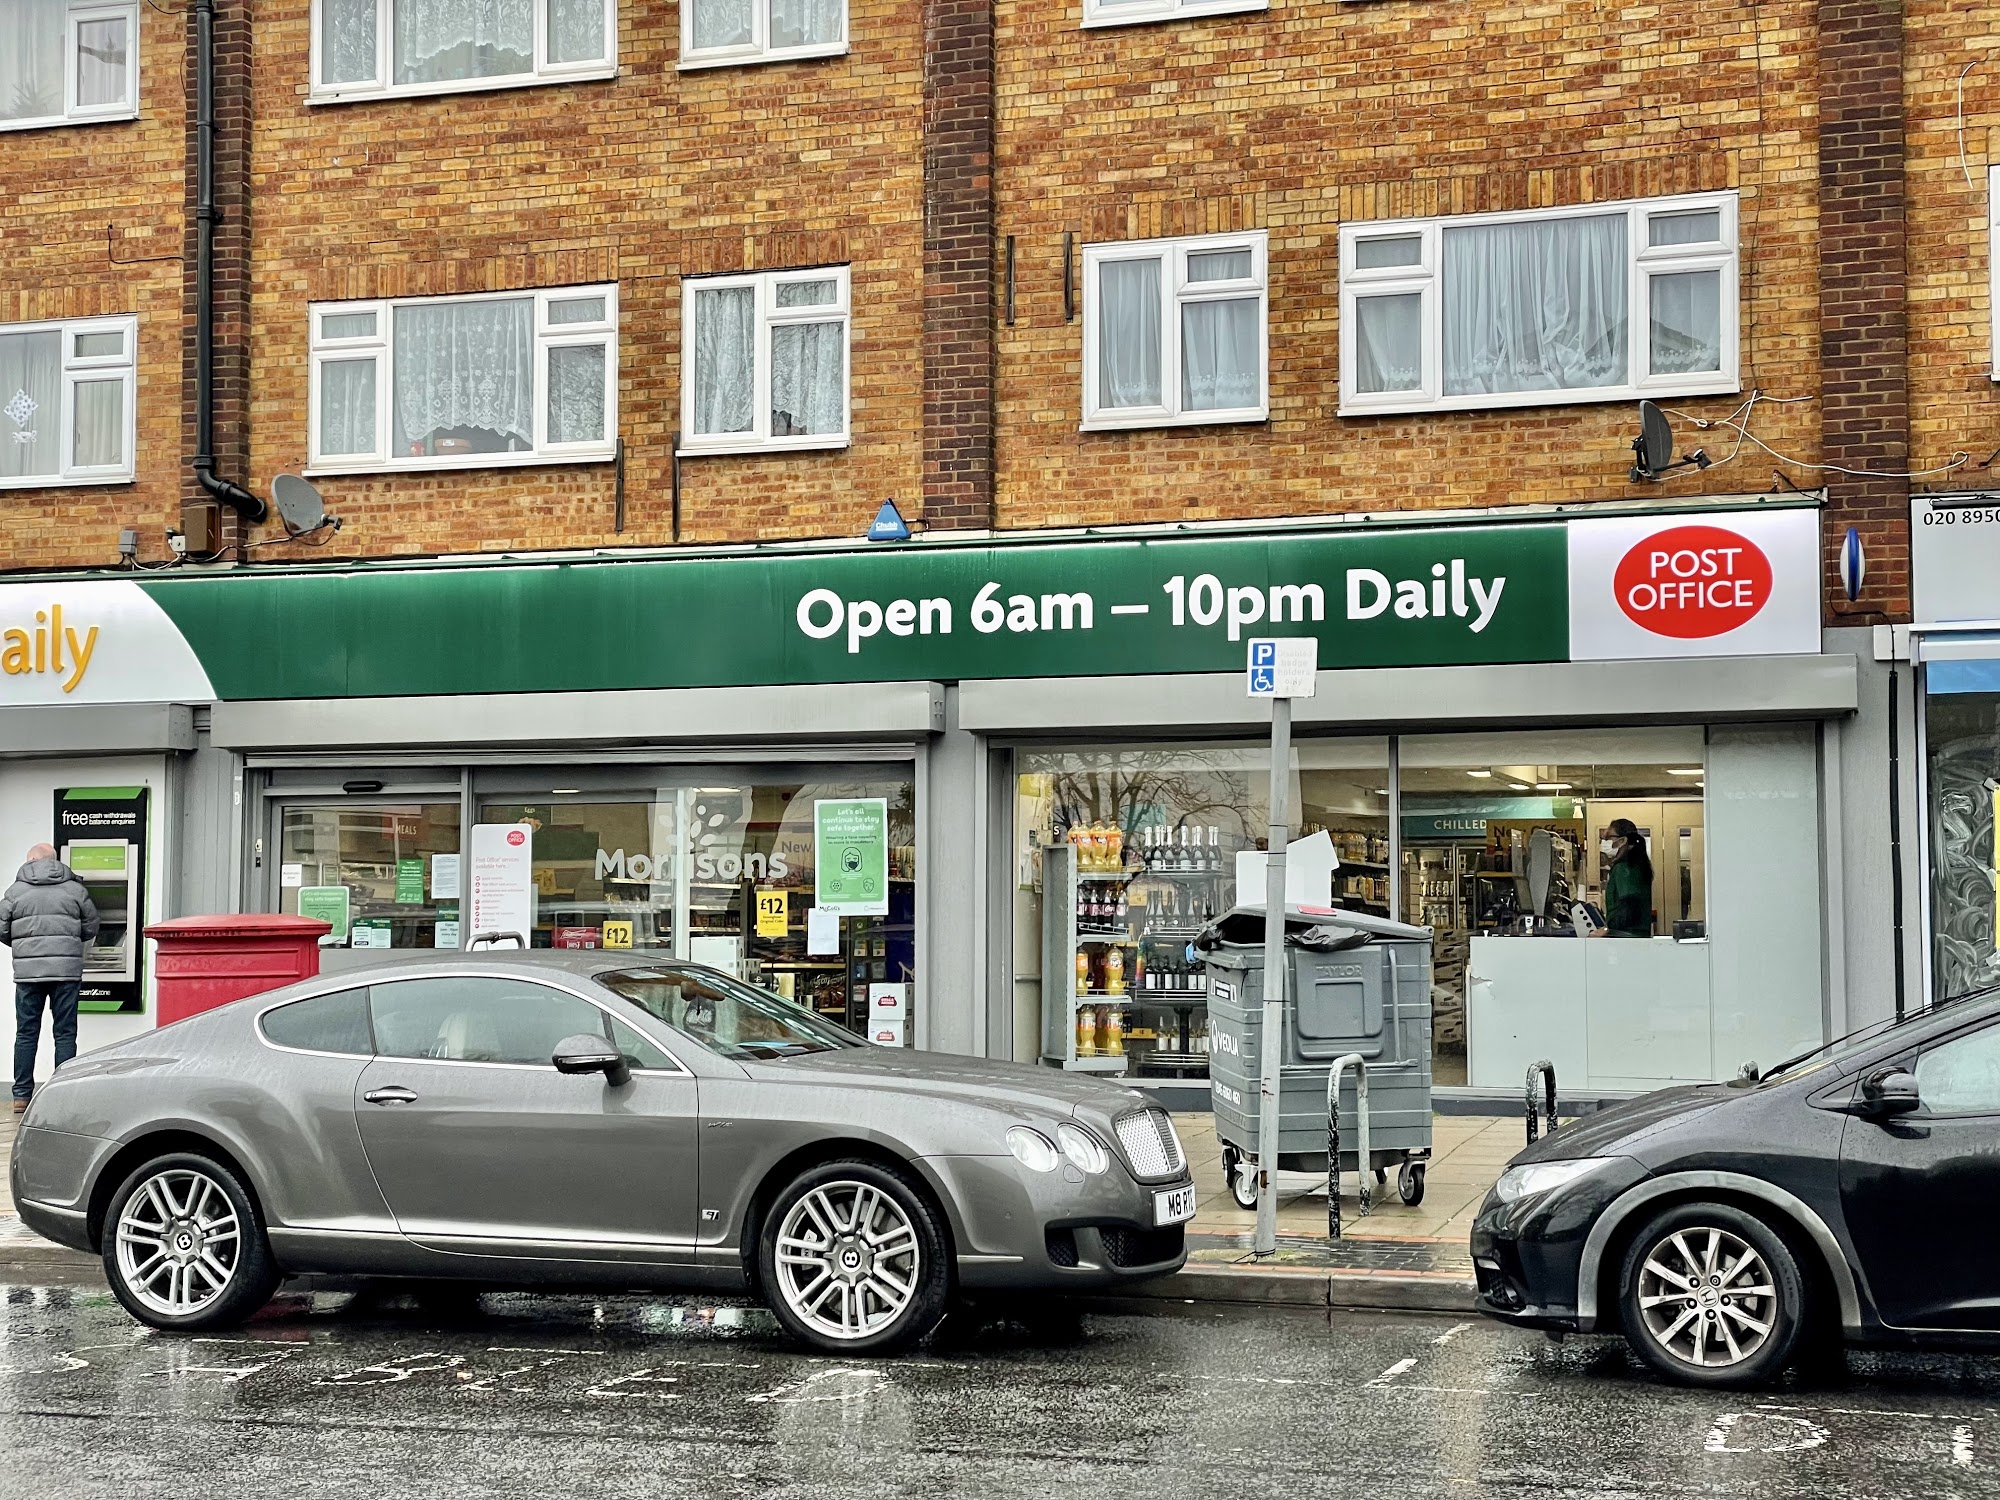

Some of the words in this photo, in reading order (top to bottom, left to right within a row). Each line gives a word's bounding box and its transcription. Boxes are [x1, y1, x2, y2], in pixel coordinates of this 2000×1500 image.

[1923, 511, 1956, 526] 020
[1650, 546, 1742, 579] POST
[1628, 579, 1754, 611] OFFICE
[796, 588, 953, 654] Open
[971, 581, 1095, 634] 6am
[1162, 574, 1325, 641] 10pm
[1345, 558, 1507, 635] Daily
[62, 810, 89, 826] free
[837, 808, 854, 816] Let's
[854, 807, 865, 815] all
[822, 816, 854, 824] continue
[864, 815, 880, 824] stay
[1433, 820, 1487, 830] CHILLED
[395, 825, 417, 835] MEALS
[826, 824, 842, 832] safe
[843, 823, 876, 833] together.
[781, 841, 811, 853] New
[760, 898, 784, 914] £12
[606, 928, 629, 944] £12
[1315, 964, 1363, 978] TAYLOR
[1218, 1030, 1239, 1057] VEOLIA
[1167, 1193, 1182, 1218] M8
